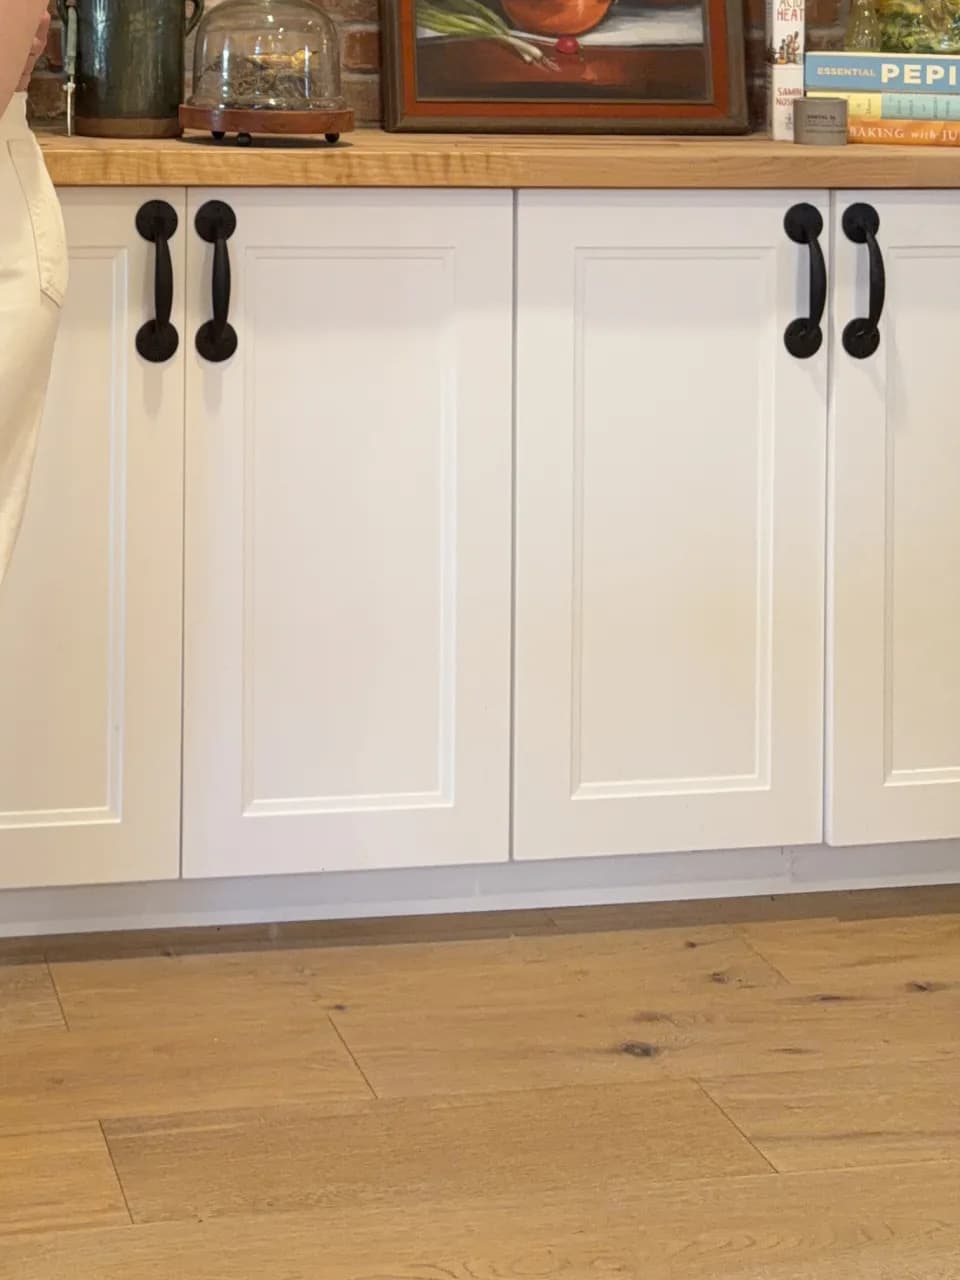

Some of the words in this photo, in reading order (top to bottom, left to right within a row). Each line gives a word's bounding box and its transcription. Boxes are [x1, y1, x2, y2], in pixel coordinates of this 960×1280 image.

[776, 8, 804, 22] HEAT
[817, 66, 876, 78] ESSENTIAL
[881, 63, 957, 86] PEPI
[849, 127, 905, 139] BAKING
[911, 129, 939, 140] with
